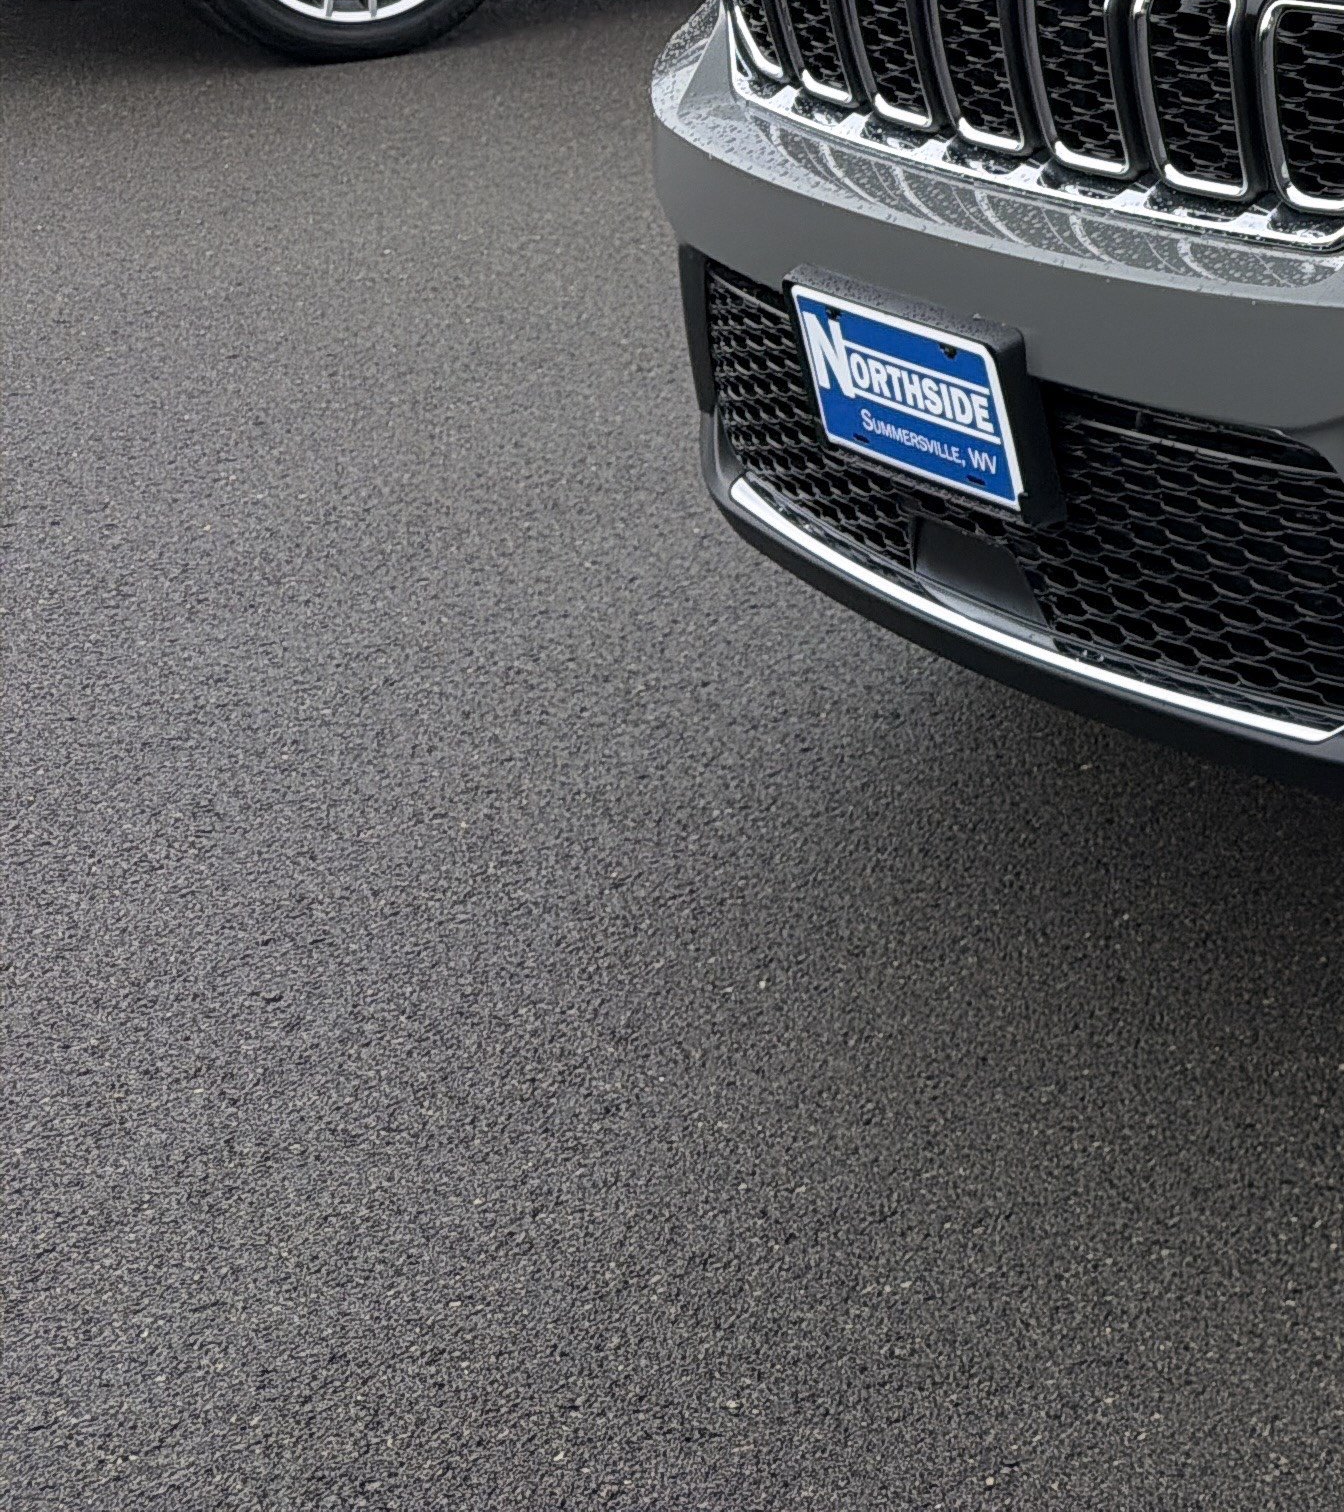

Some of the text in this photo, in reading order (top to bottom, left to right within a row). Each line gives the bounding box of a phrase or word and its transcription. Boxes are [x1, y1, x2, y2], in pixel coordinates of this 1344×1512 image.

[802, 310, 996, 435] NORTHSIDE
[860, 408, 997, 475] SUMMERSVILLE, WV
